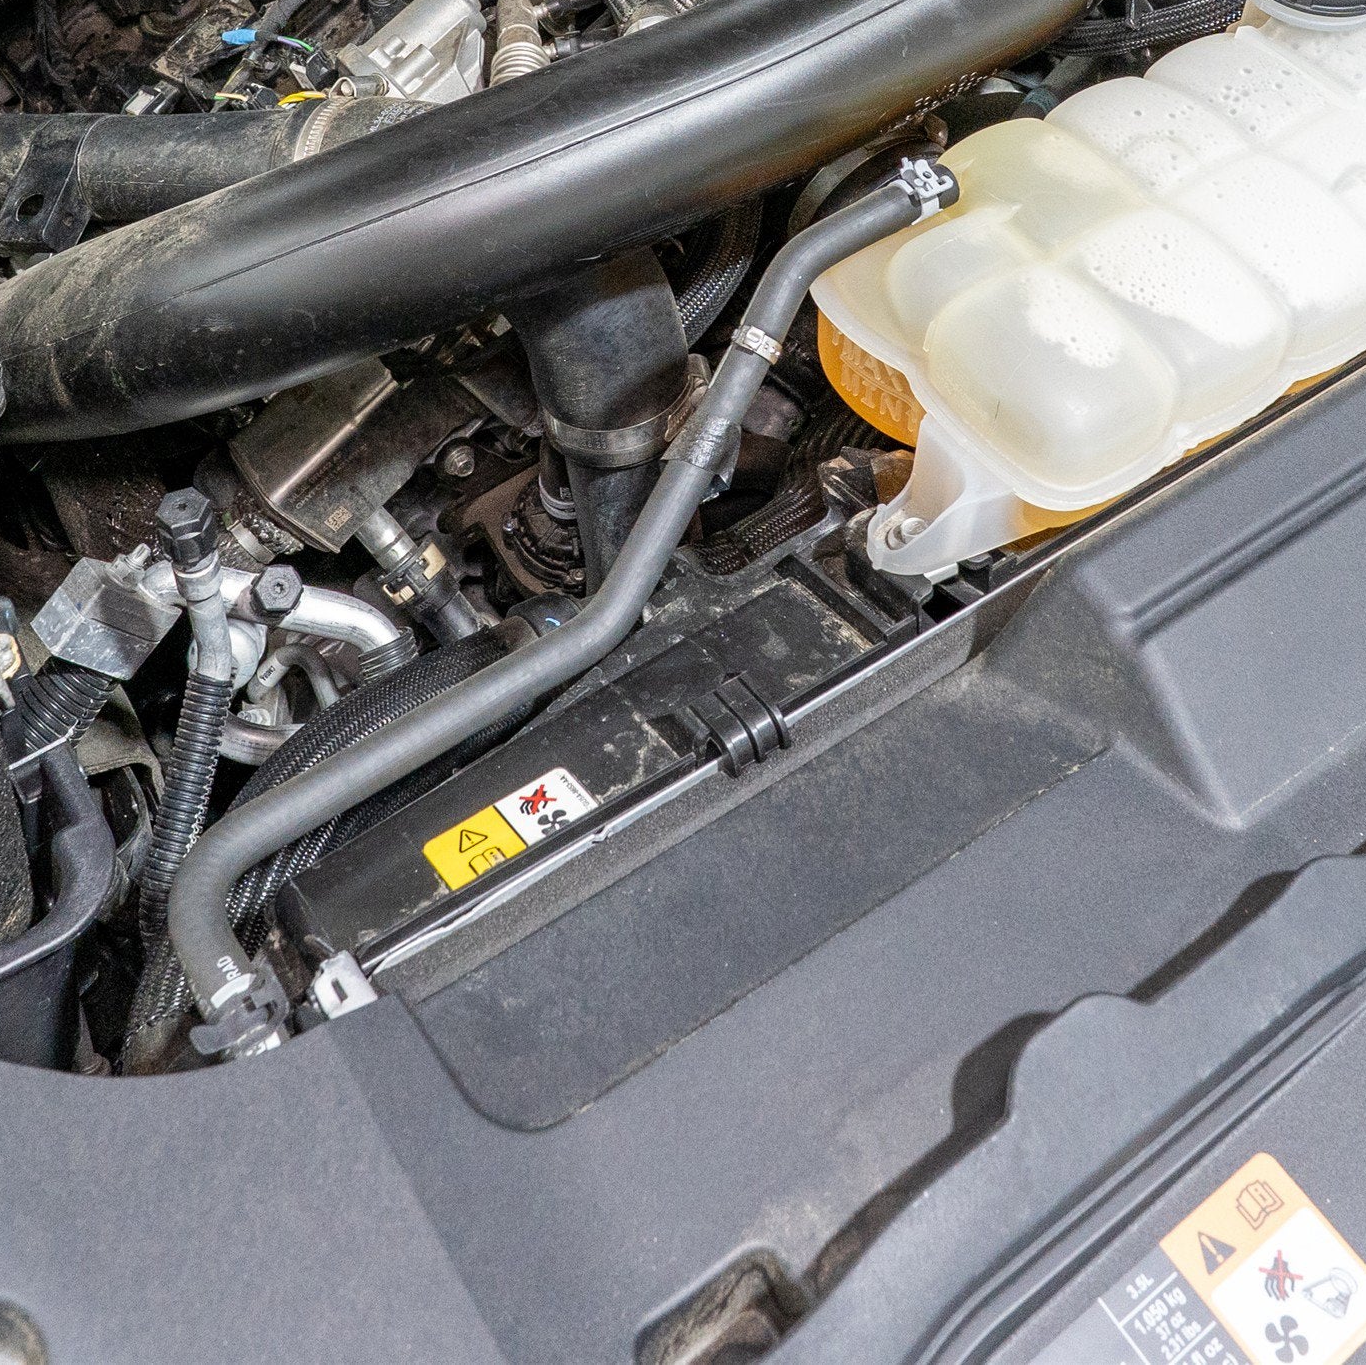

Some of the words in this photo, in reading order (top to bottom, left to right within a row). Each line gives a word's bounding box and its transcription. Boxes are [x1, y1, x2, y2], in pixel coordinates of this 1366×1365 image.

[841, 363, 902, 422] MIN
[216, 955, 241, 980] RAD
[1134, 1299, 1169, 1334] 1.050
[1163, 1287, 1187, 1308] kg
[1155, 1321, 1172, 1340] 37
[1170, 1311, 1186, 1328] oz
[1161, 1333, 1185, 1360] 2.31
[1204, 1338, 1224, 1358] oz
